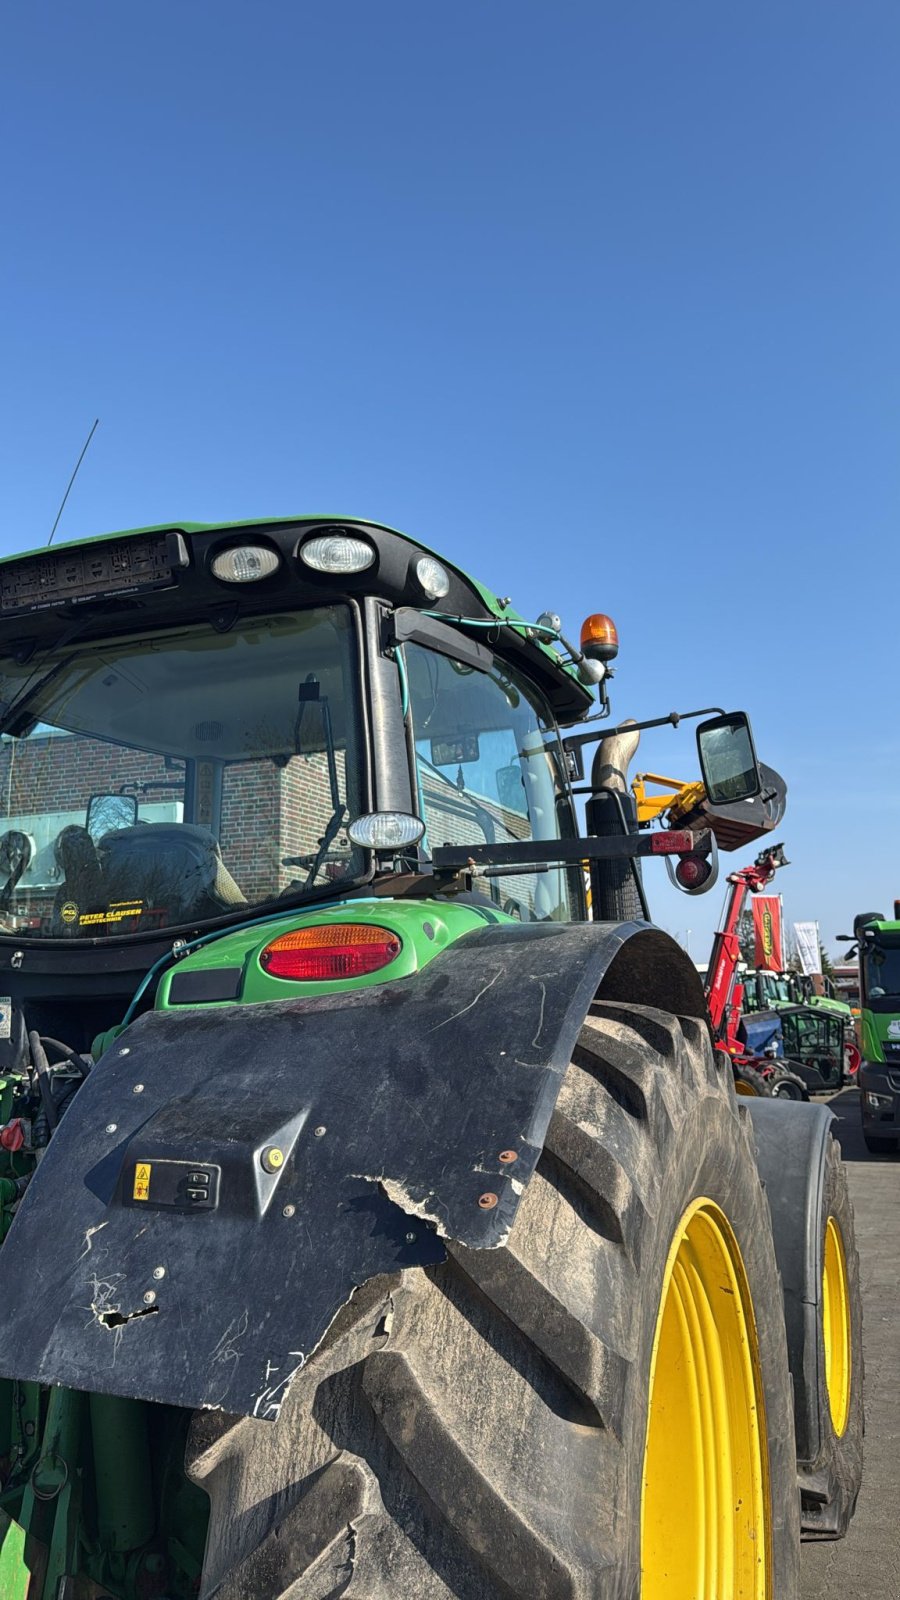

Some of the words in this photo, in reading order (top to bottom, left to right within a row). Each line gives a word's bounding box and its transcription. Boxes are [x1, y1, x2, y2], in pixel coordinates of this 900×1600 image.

[80, 912, 105, 921] PETER
[106, 909, 142, 918] CLAUSEN
[80, 916, 122, 925] LANDTECHNIK
